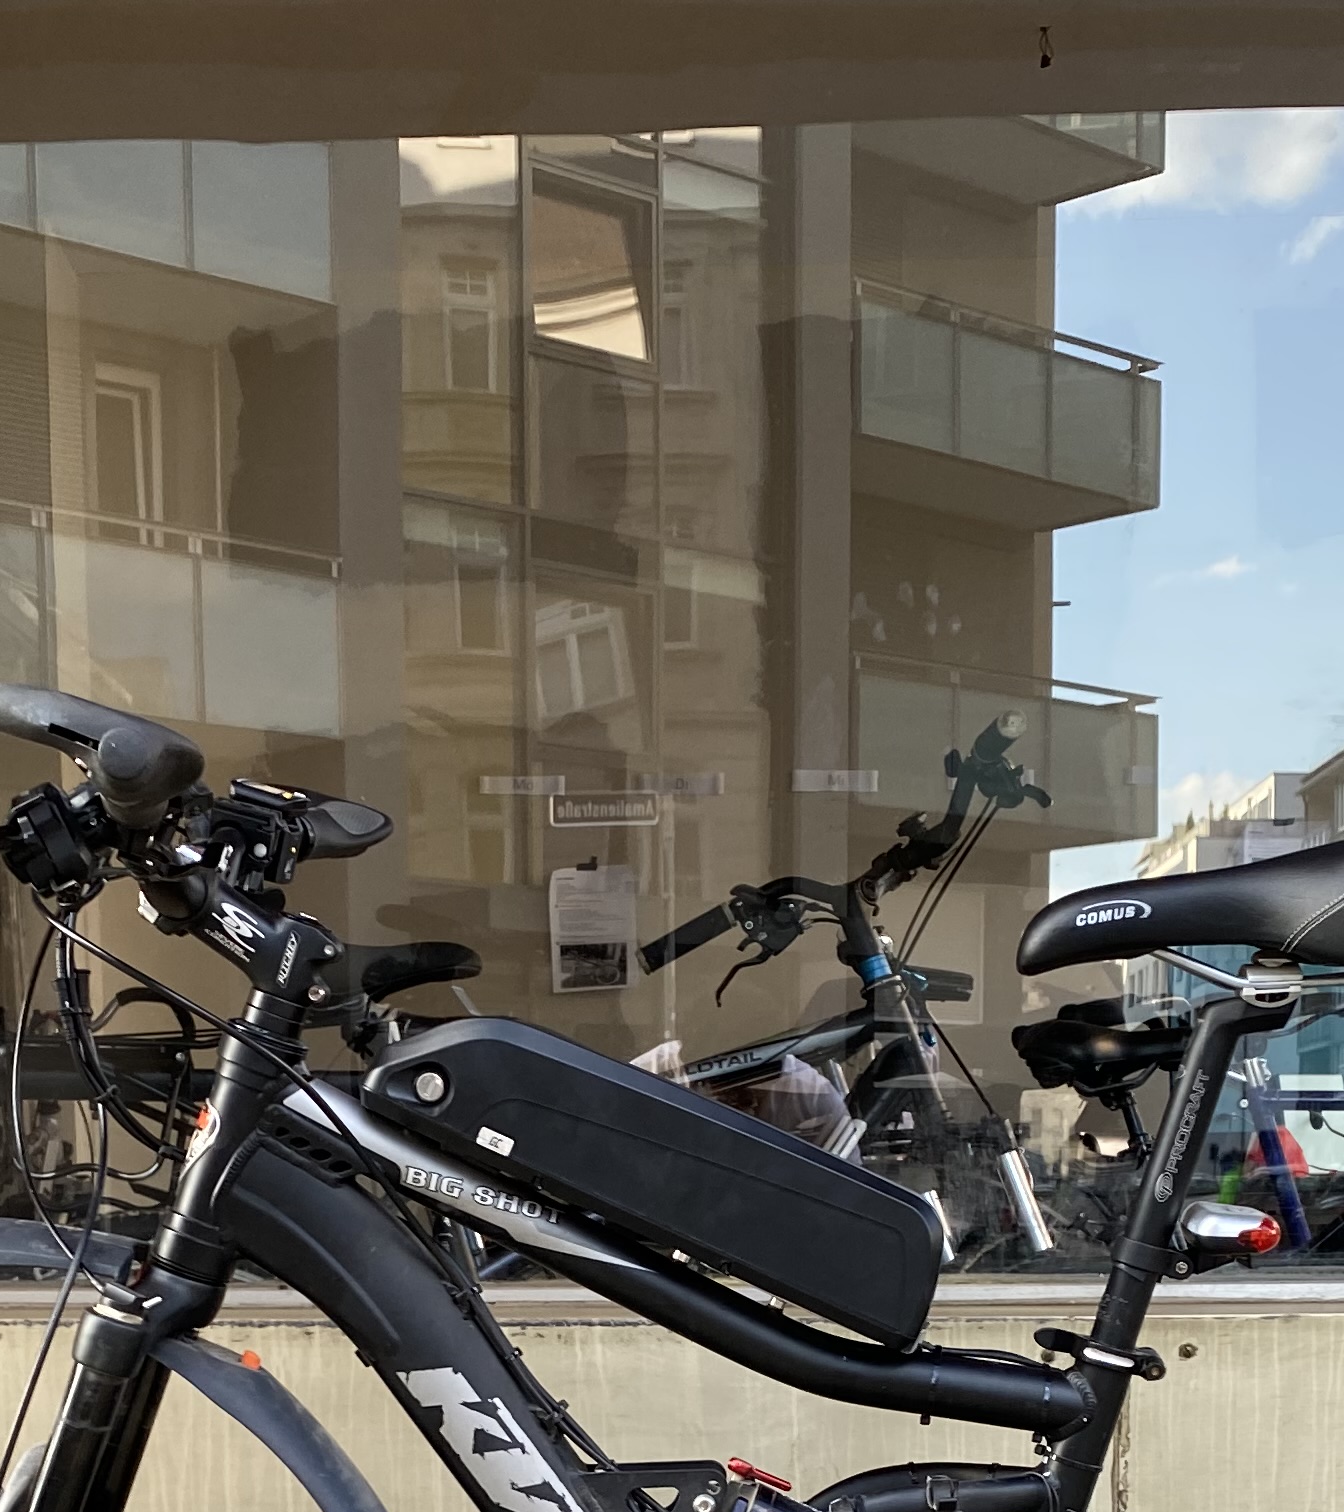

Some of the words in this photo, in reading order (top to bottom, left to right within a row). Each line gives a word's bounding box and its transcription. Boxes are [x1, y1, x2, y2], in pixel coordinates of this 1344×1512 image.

[1075, 905, 1136, 927] COMUS
[277, 932, 297, 985] RITCHEY
[1164, 1068, 1210, 1174] PROCRAFT
[405, 1165, 464, 1199] BIG
[471, 1185, 566, 1225] SHOT
